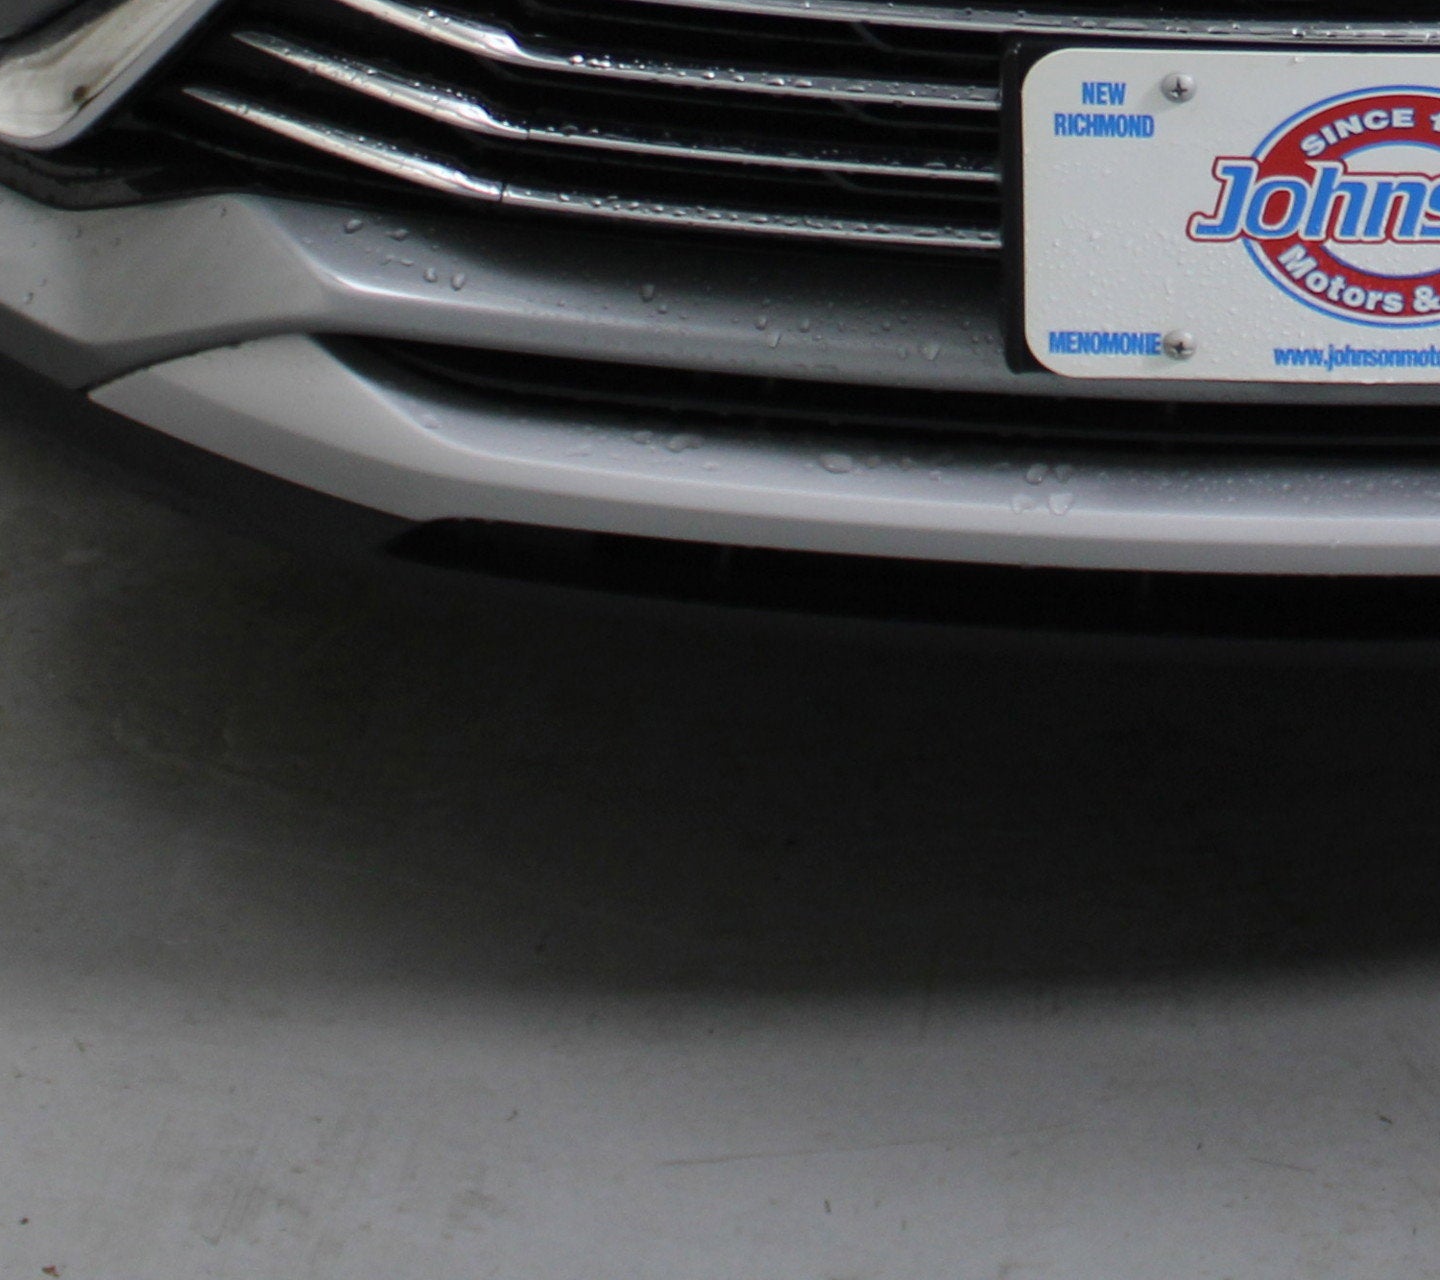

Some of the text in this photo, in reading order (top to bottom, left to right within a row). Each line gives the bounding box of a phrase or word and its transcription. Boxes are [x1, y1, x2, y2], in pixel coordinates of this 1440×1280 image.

[1081, 81, 1127, 106] NEW
[1053, 112, 1155, 138] RICHMOND
[1300, 107, 1416, 158] SINCE
[1276, 242, 1405, 314] Motors
[1048, 330, 1161, 357] MENOMONIE
